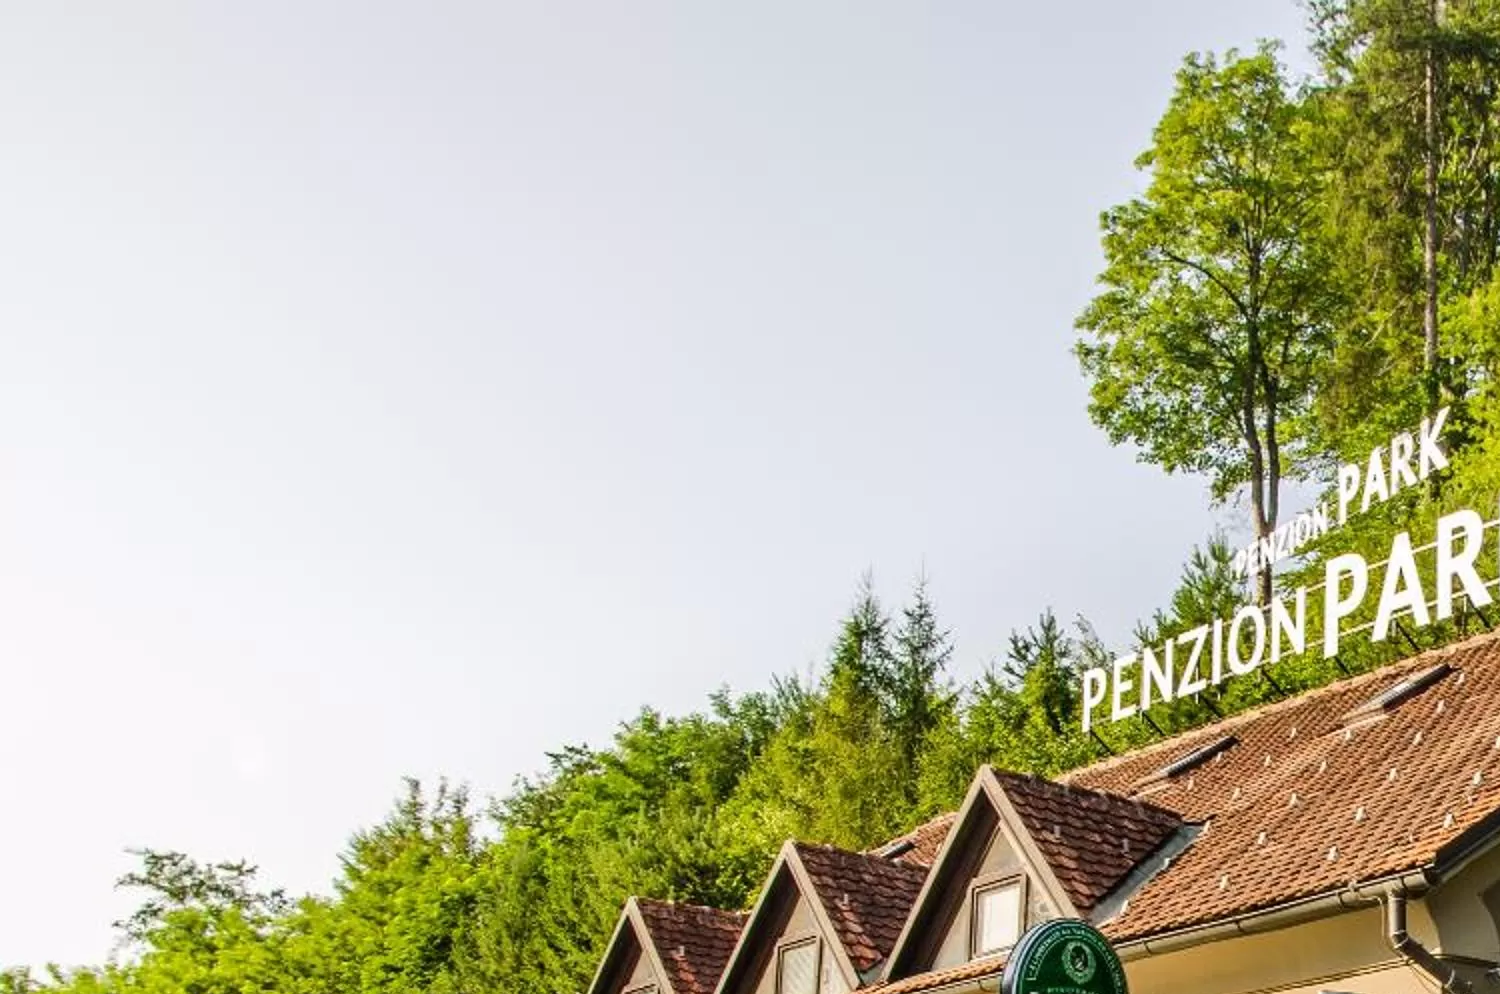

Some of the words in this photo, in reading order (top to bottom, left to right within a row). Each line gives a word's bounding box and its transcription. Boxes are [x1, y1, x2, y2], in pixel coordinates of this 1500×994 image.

[1230, 502, 1328, 579] PENZION
[1337, 406, 1451, 525] PARK
[1081, 587, 1307, 733] PENZION
